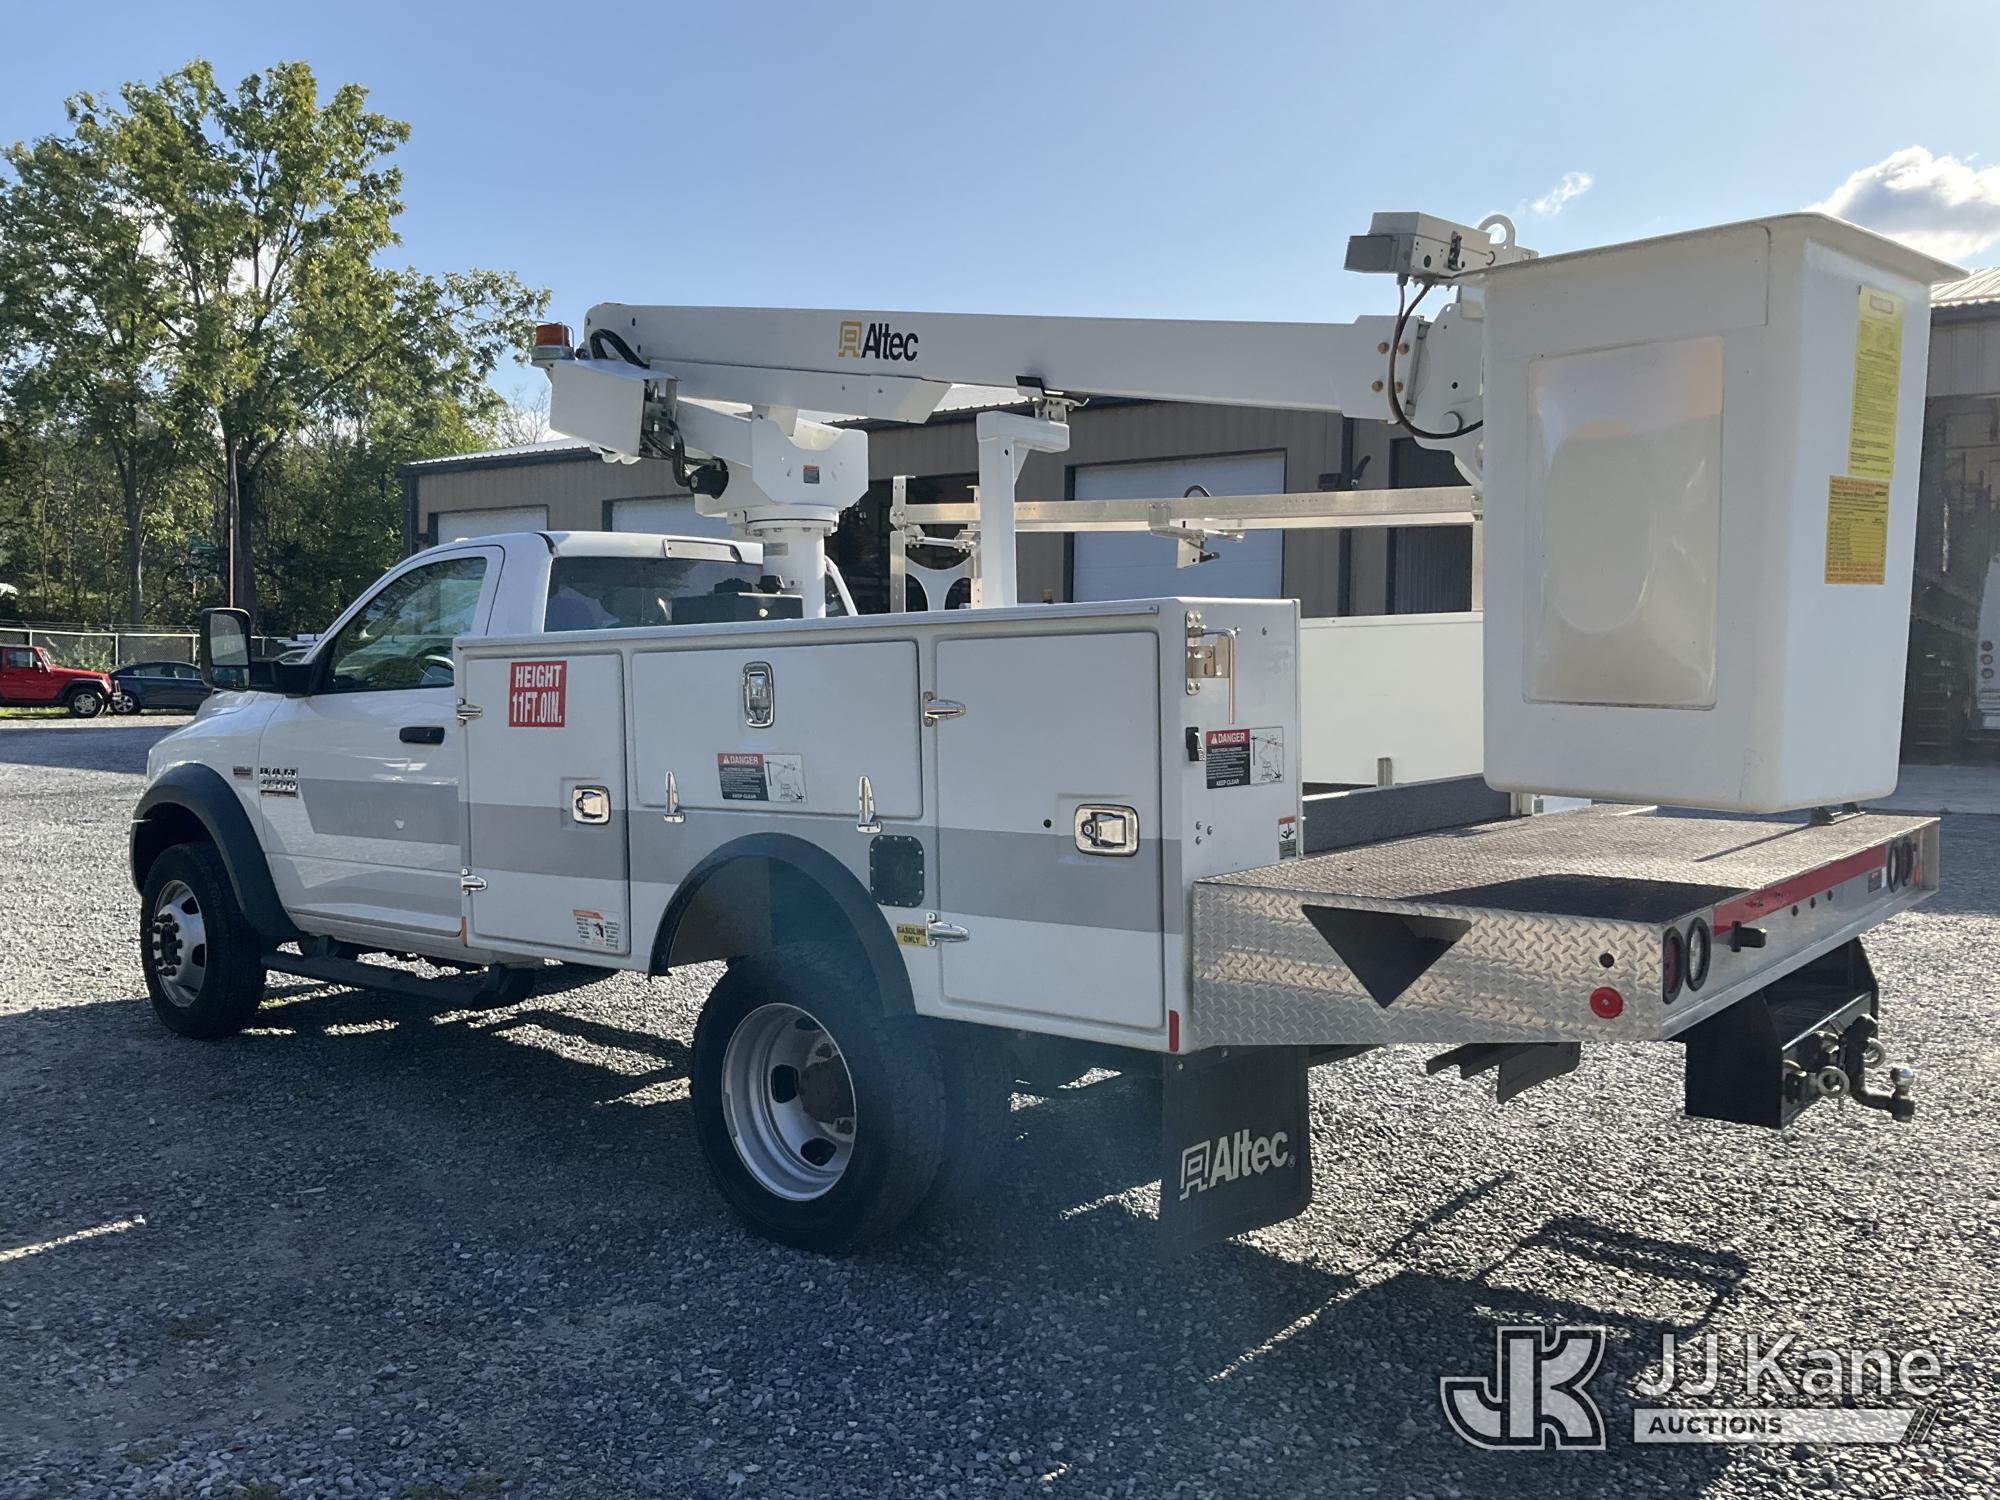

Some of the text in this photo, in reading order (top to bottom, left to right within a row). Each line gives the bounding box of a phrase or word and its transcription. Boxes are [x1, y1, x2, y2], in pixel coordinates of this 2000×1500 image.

[861, 322, 919, 361] Altec
[515, 665, 562, 688] HEIGHT
[1218, 732, 1245, 744] DANGER
[730, 755, 759, 765] DANGER
[260, 767, 297, 778] RAM
[897, 926, 926, 936] GASOLINE
[903, 934, 921, 944] ONLY
[1209, 1129, 1288, 1188] Altec
